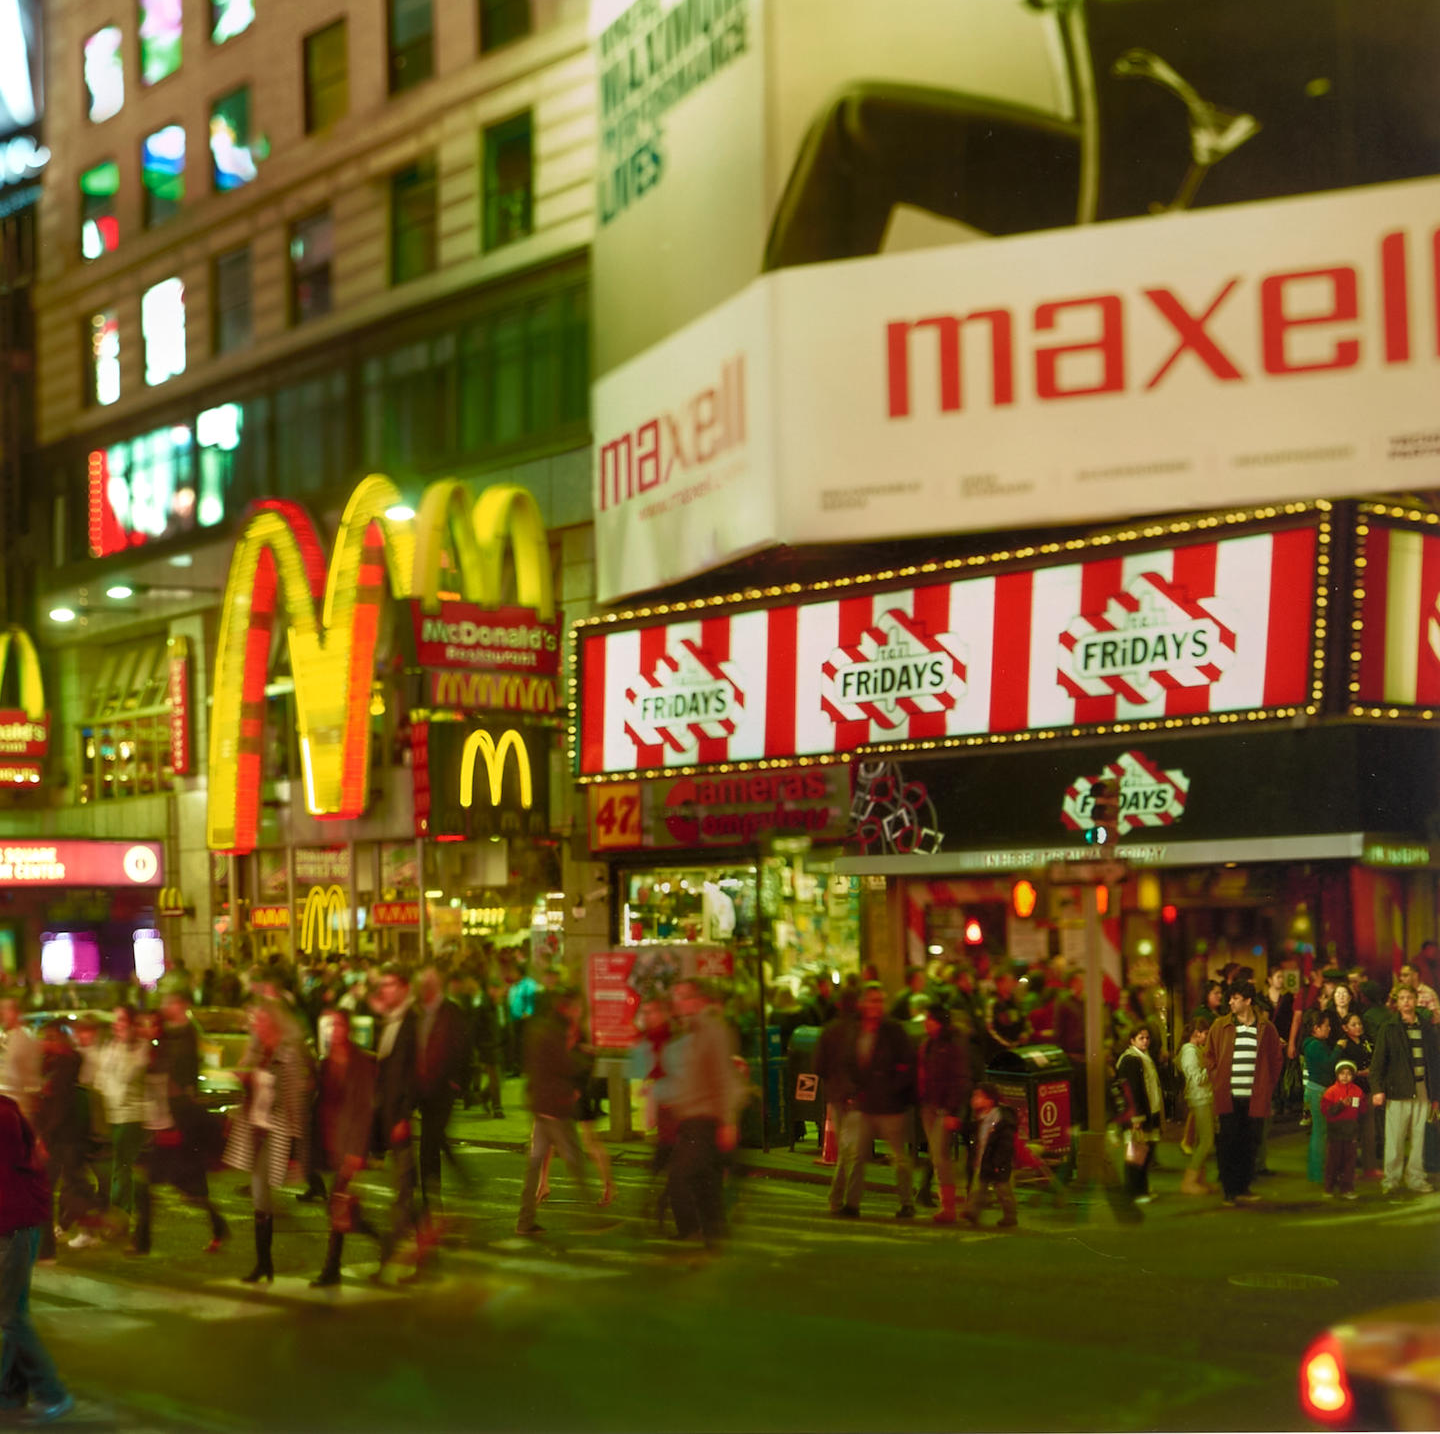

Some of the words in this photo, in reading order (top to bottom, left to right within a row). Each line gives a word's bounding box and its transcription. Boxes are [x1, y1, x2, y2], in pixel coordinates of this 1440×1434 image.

[600, 354, 746, 511] maxell
[422, 618, 556, 652] McDonald's
[1082, 629, 1210, 671] FRiDAYS
[841, 661, 944, 698] FRiDAYS
